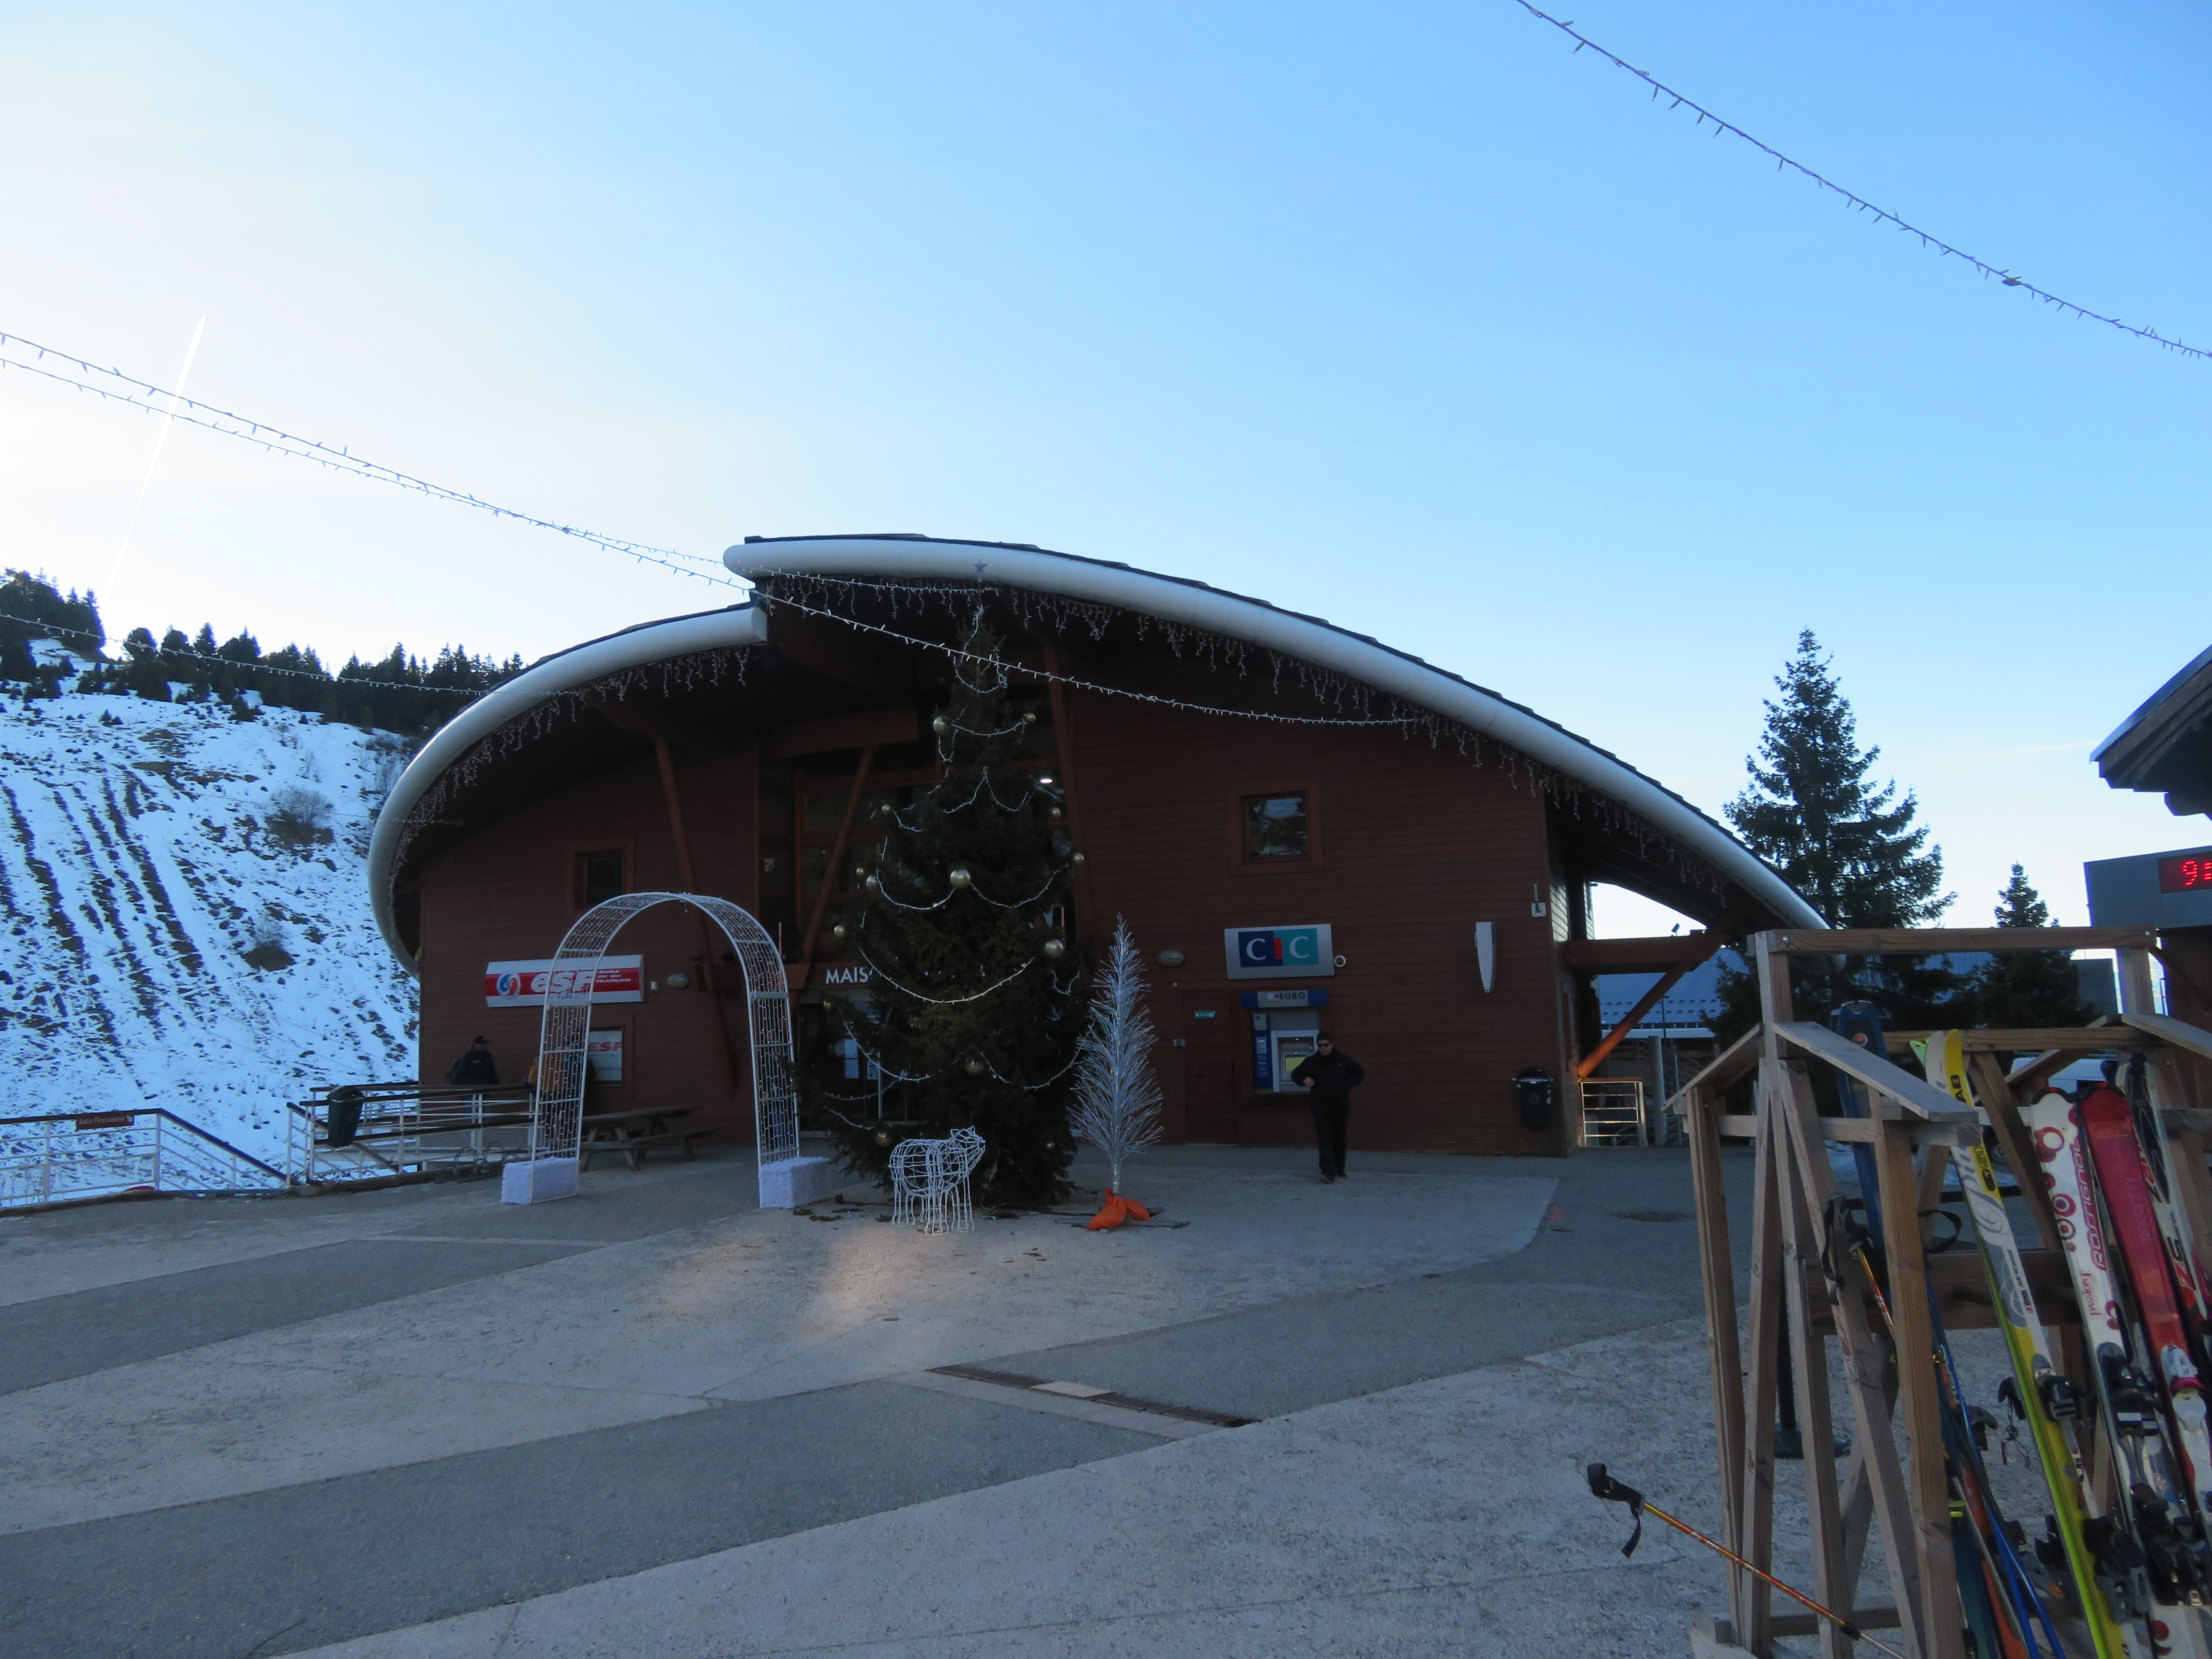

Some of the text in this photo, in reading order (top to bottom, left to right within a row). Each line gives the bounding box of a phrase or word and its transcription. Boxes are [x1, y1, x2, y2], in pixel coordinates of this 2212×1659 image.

[1246, 936, 1310, 960] CIC
[826, 967, 869, 984] MAIS
[1280, 991, 1306, 1000] EURO
[588, 1042, 622, 1052] ESF
[2069, 1136, 2107, 1270] ROSSIGNOL
